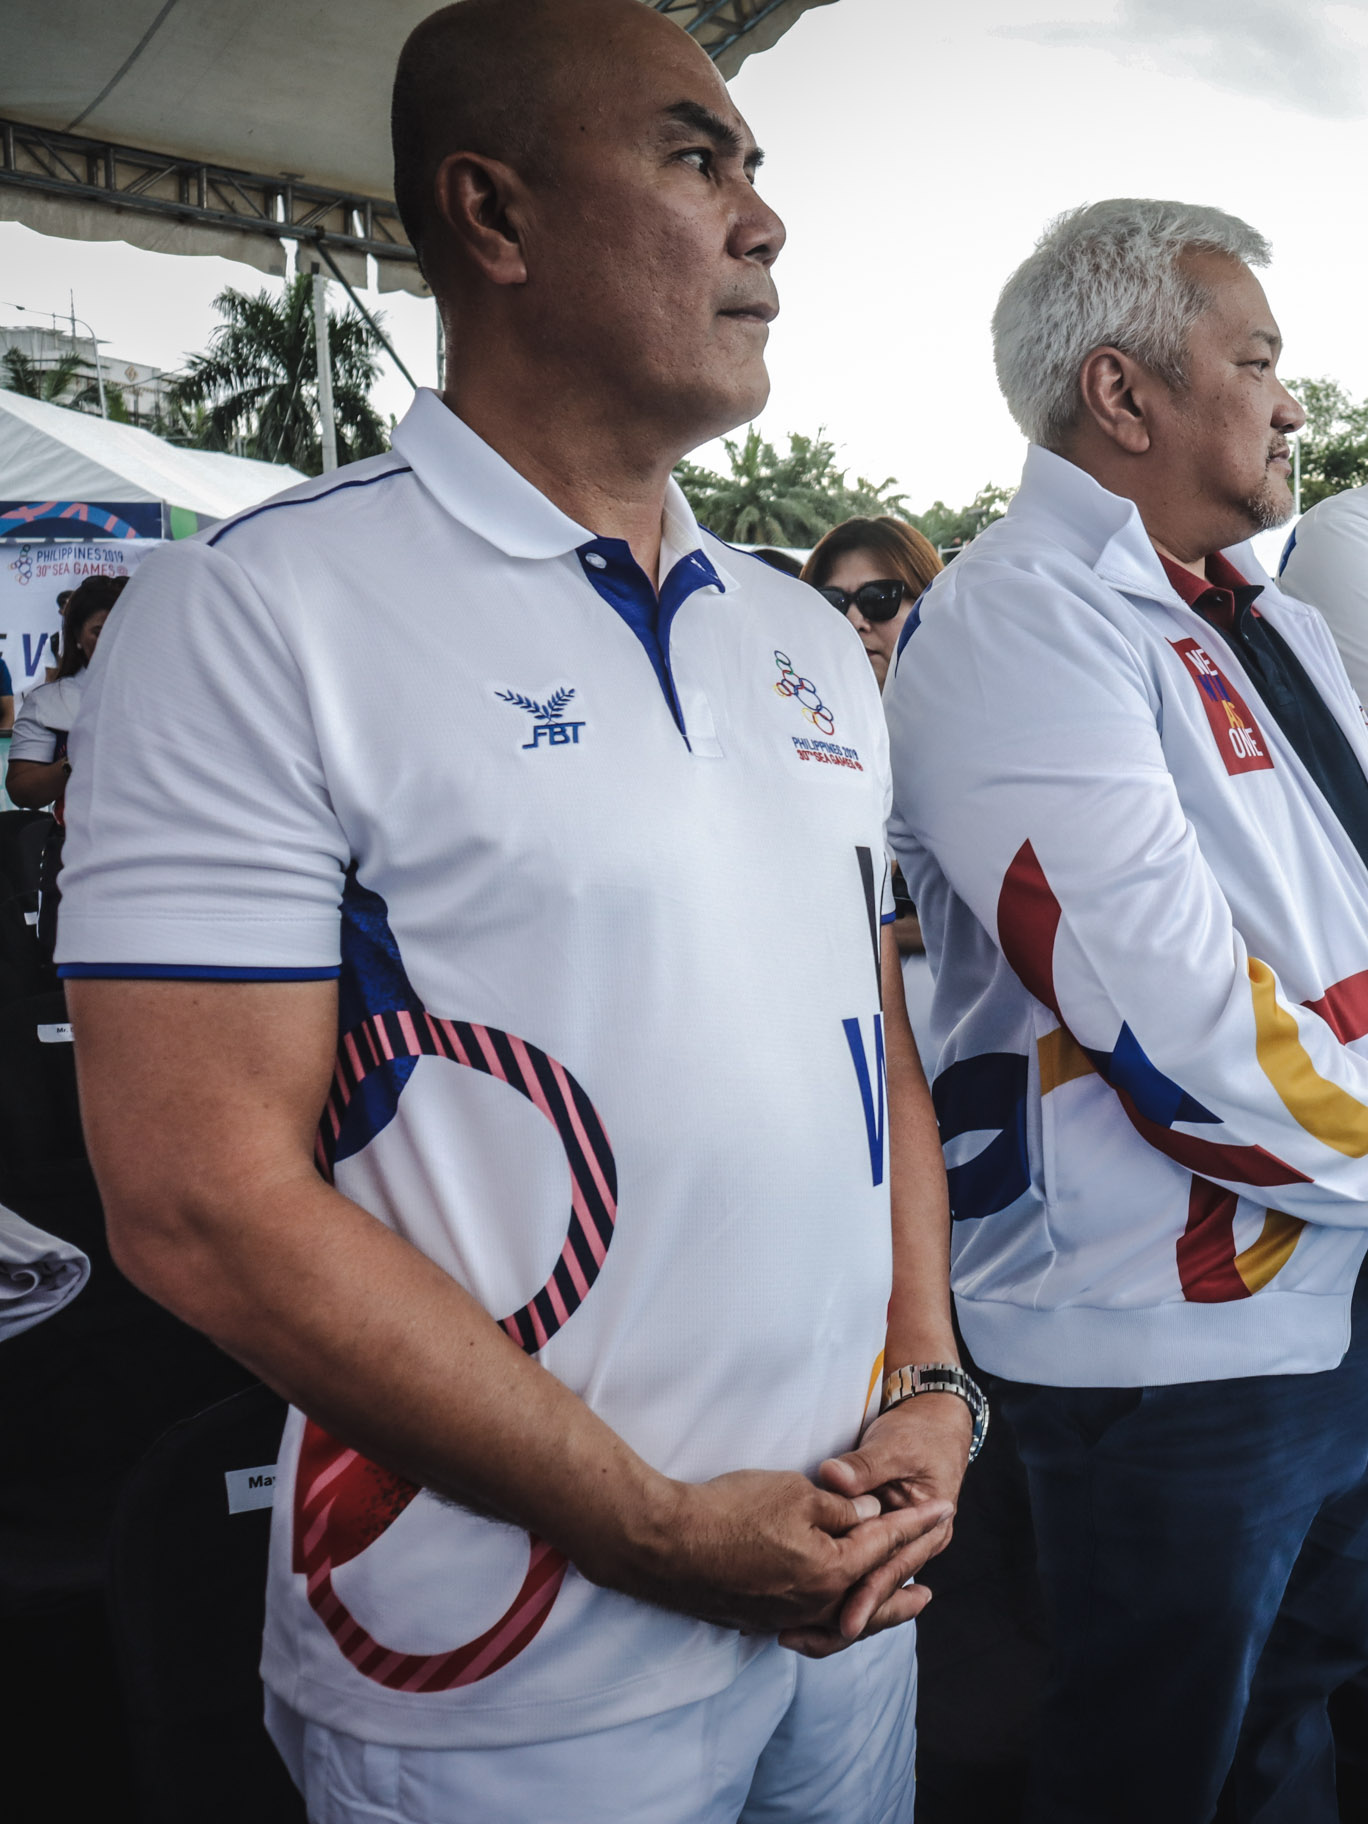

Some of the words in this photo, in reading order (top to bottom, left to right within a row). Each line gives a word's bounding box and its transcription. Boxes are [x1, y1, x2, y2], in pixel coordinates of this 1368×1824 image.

[36, 547, 102, 563] PHILIPPINES
[103, 549, 124, 563] 2019
[53, 565, 70, 577] SEA
[73, 563, 115, 577] GAMES
[1185, 649, 1219, 676] WE
[1221, 700, 1245, 729] AS
[522, 721, 586, 749] FBT
[792, 736, 843, 756] PHILIPPINES
[1228, 727, 1264, 759] ONE
